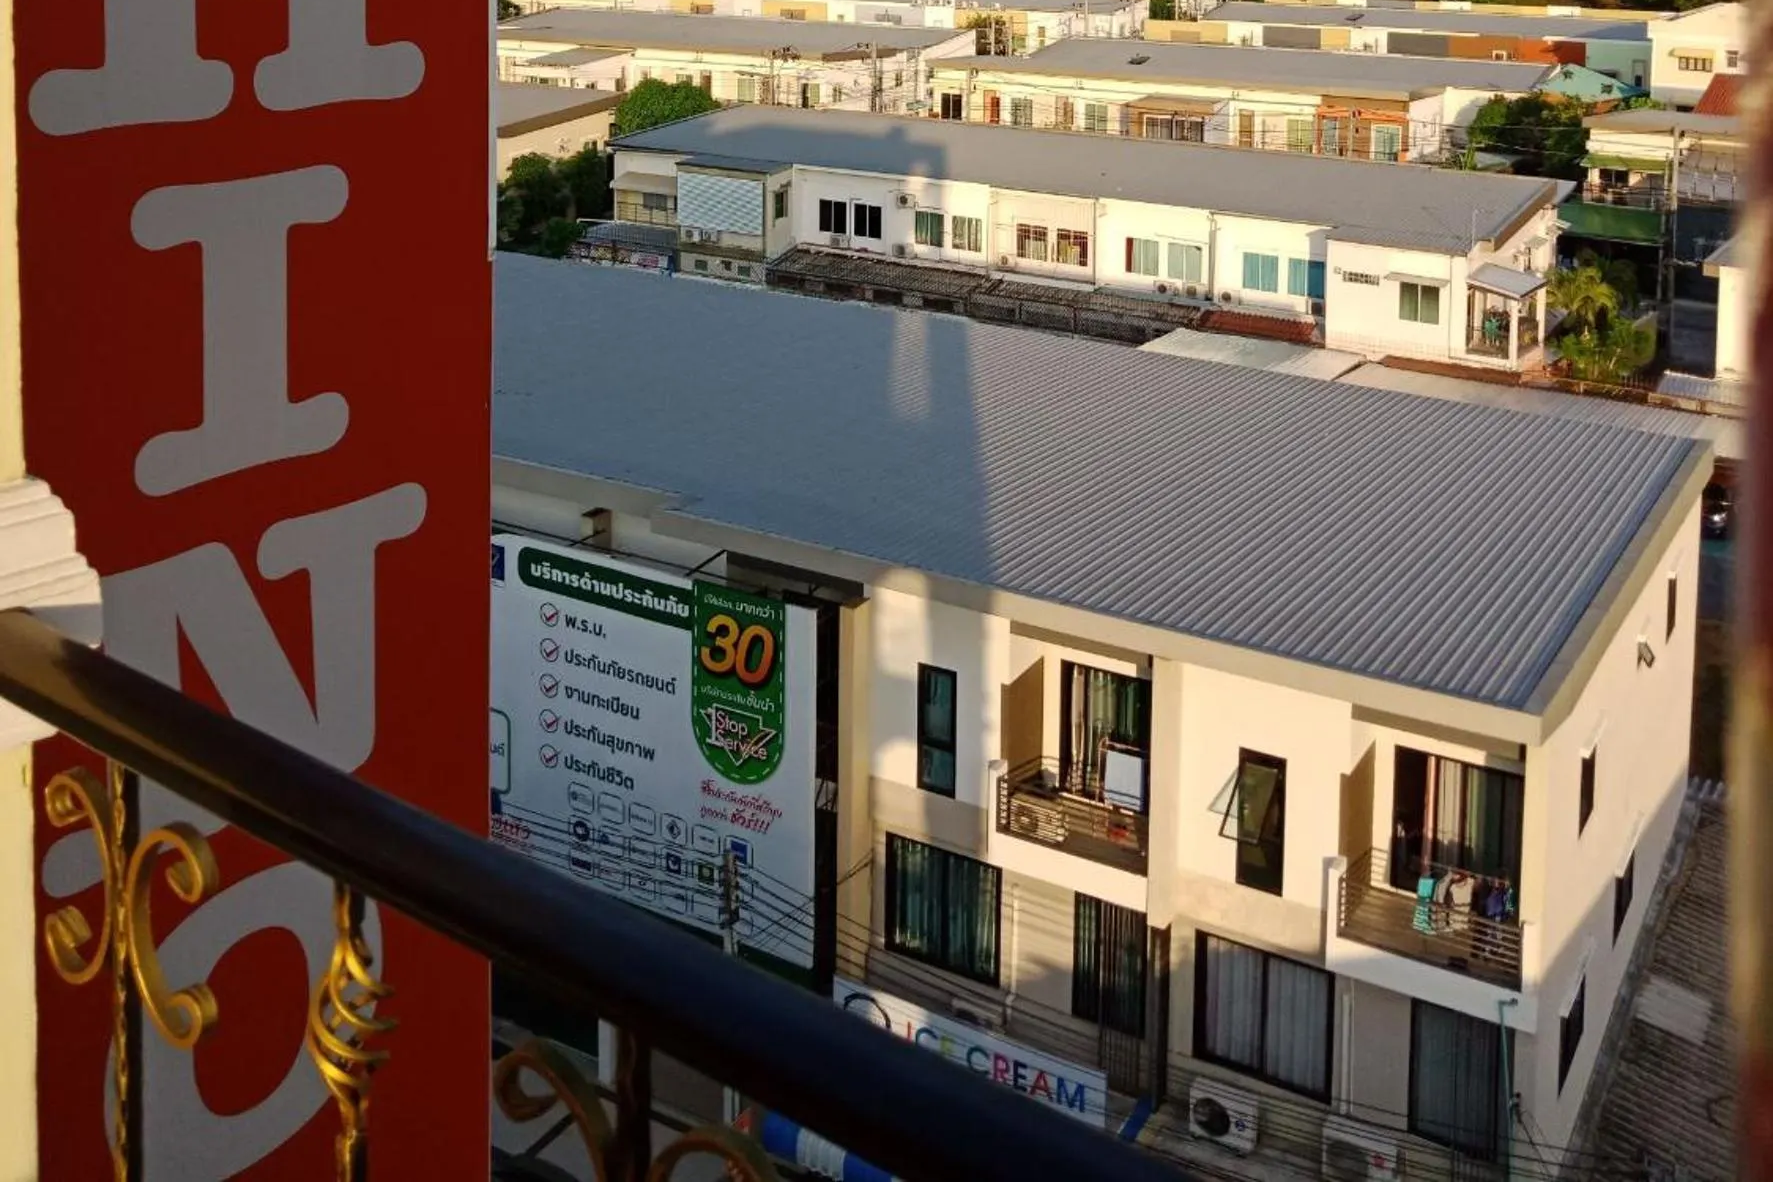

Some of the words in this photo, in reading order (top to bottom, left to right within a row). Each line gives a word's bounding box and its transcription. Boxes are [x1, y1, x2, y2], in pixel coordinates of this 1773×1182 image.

[531, 562, 690, 617] บริการด้านประกันภัย
[565, 614, 607, 639] พ.ร.บ.
[700, 614, 776, 684] 30
[564, 648, 677, 695] ประกันภัยรถยนต์
[564, 685, 640, 719] งานทะเบียน
[564, 719, 656, 762] ประกันสุขภาพ
[715, 729, 768, 760] Service
[716, 710, 748, 740] Stop
[564, 754, 635, 791] ประกันชีวิต
[966, 1046, 1086, 1113] CREAM
